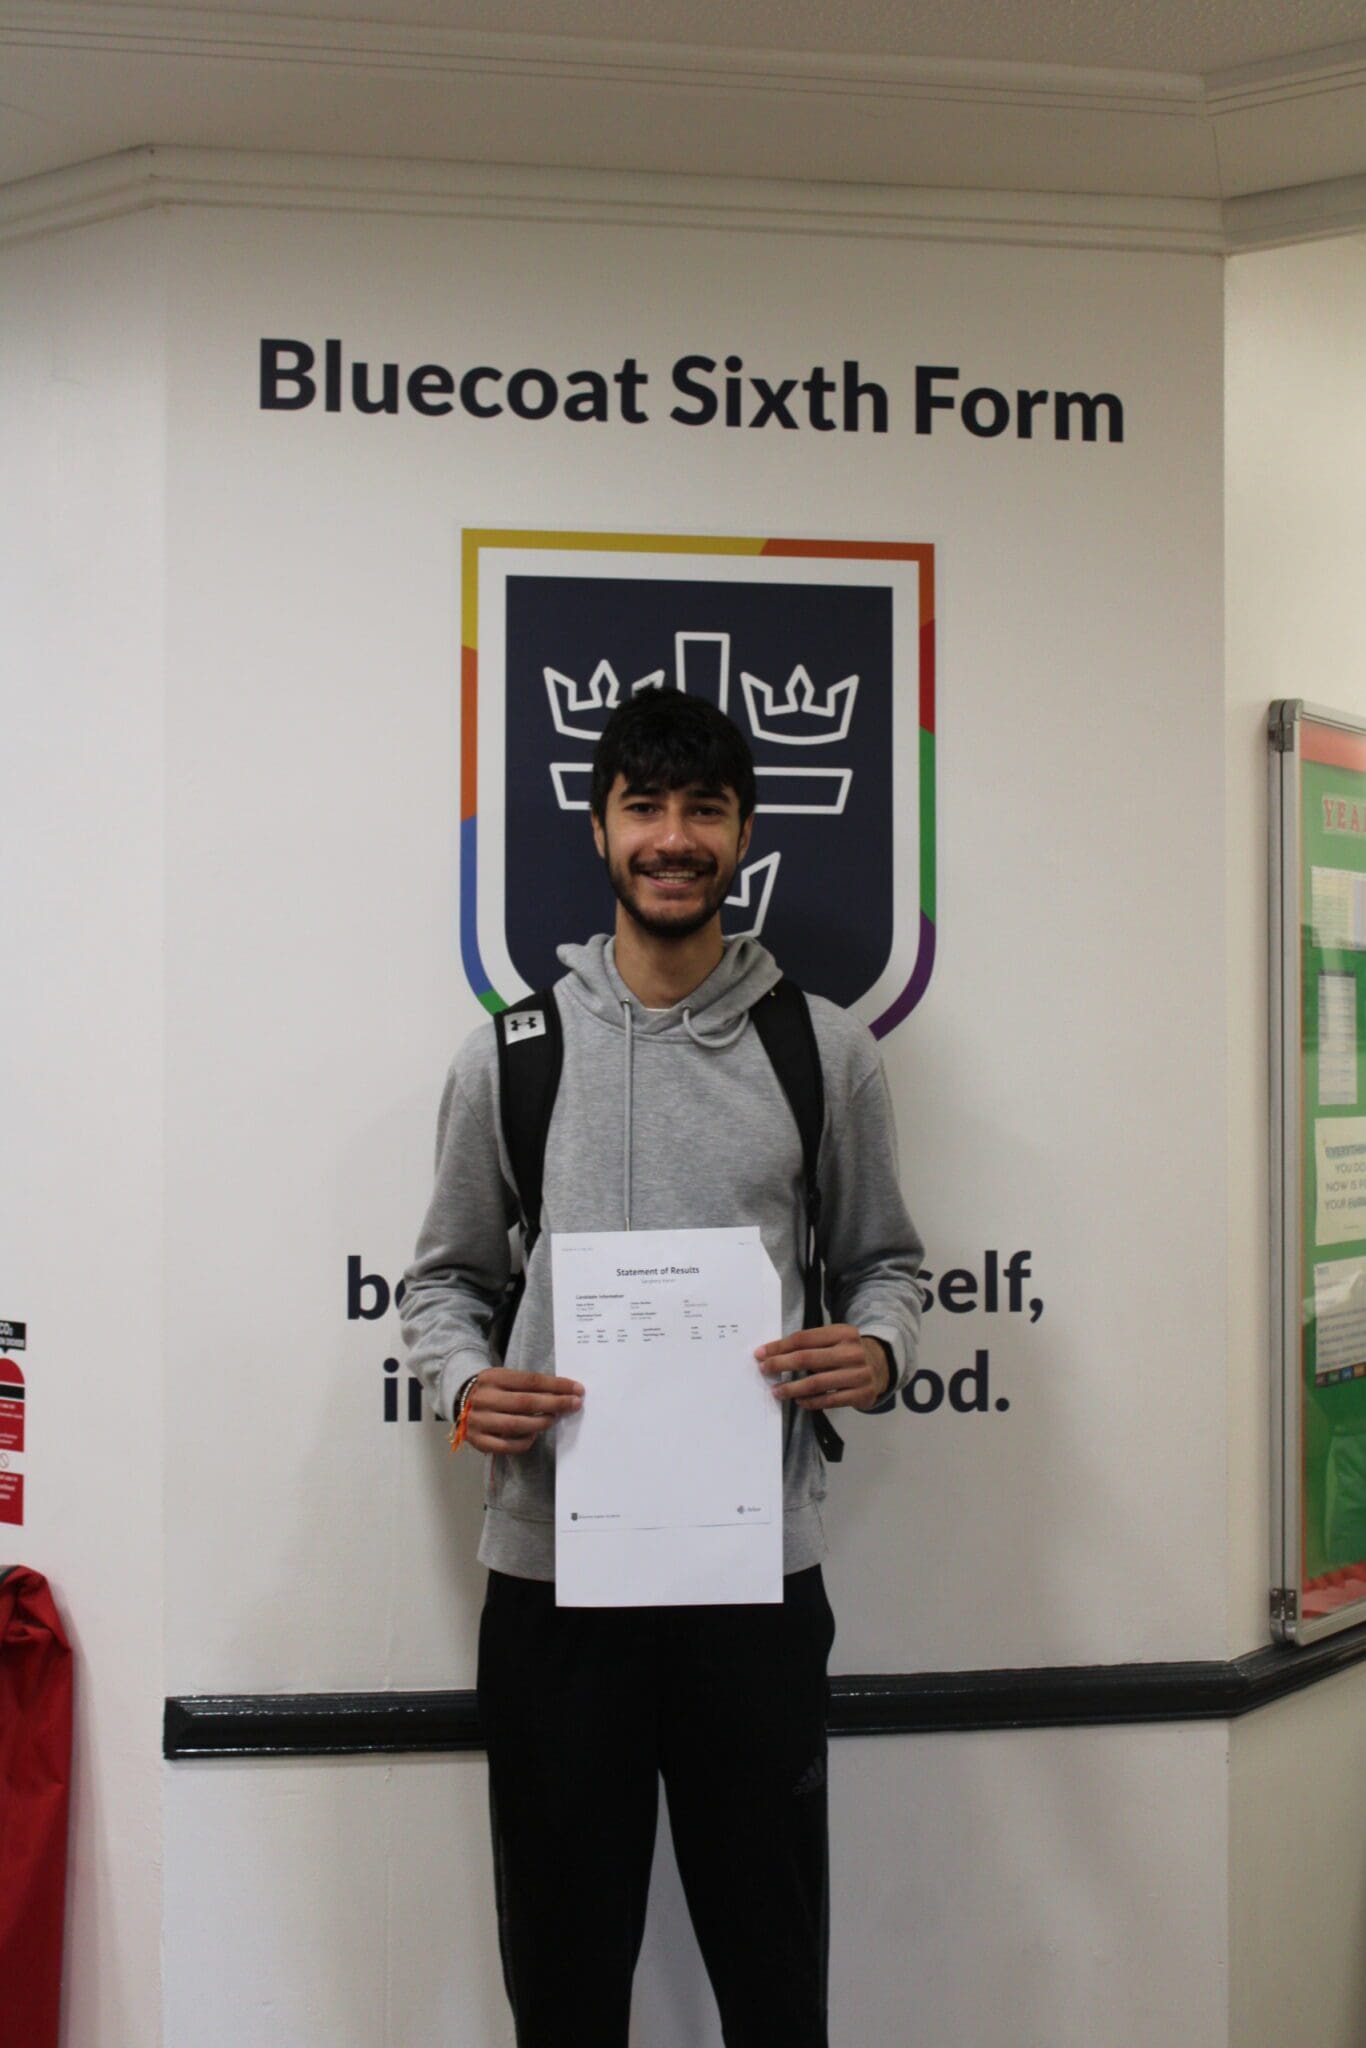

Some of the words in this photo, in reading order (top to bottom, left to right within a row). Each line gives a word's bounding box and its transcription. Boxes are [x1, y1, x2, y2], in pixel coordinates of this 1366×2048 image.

[261, 339, 648, 423] Bluecoat
[671, 356, 887, 432] Sixth
[916, 366, 1123, 442] Form
[616, 1267, 658, 1277] Statement
[660, 1267, 669, 1275] of
[671, 1265, 700, 1275] Results
